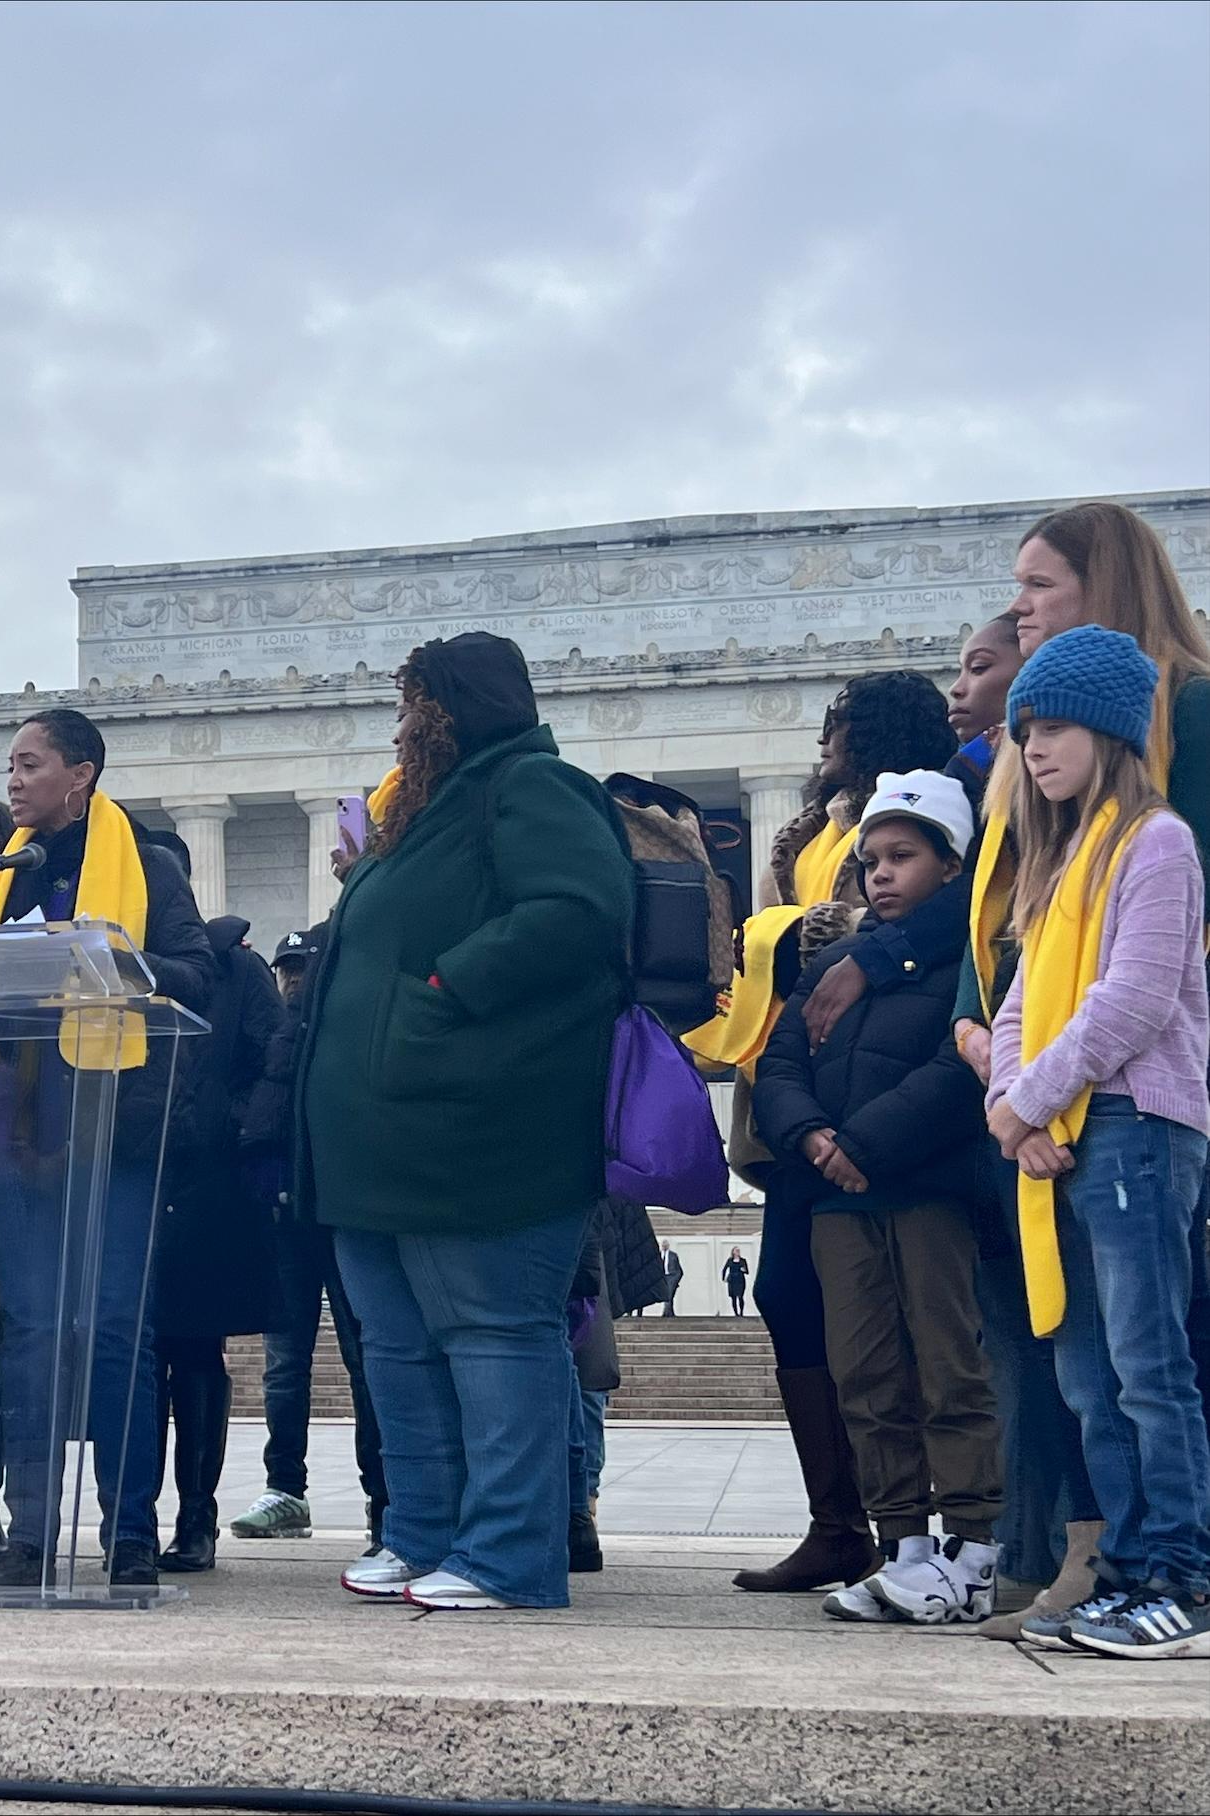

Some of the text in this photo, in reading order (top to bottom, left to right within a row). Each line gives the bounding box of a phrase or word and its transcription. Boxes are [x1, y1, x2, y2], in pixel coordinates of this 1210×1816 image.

[103, 642, 166, 657] ARKANSAS
[178, 637, 243, 651] MICHIGAN
[256, 632, 310, 646] FLORIDA
[327, 628, 367, 642] TEXAS
[384, 625, 422, 639] IOWA
[438, 619, 515, 633] WISCONSIN
[528, 613, 609, 628] CALIFORNIA
[624, 606, 704, 621] MINNESOTA
[719, 601, 777, 616] OREGON
[791, 597, 844, 611] KANSAS
[857, 593, 894, 607] WEST
[899, 589, 964, 604] VIRGINIA
